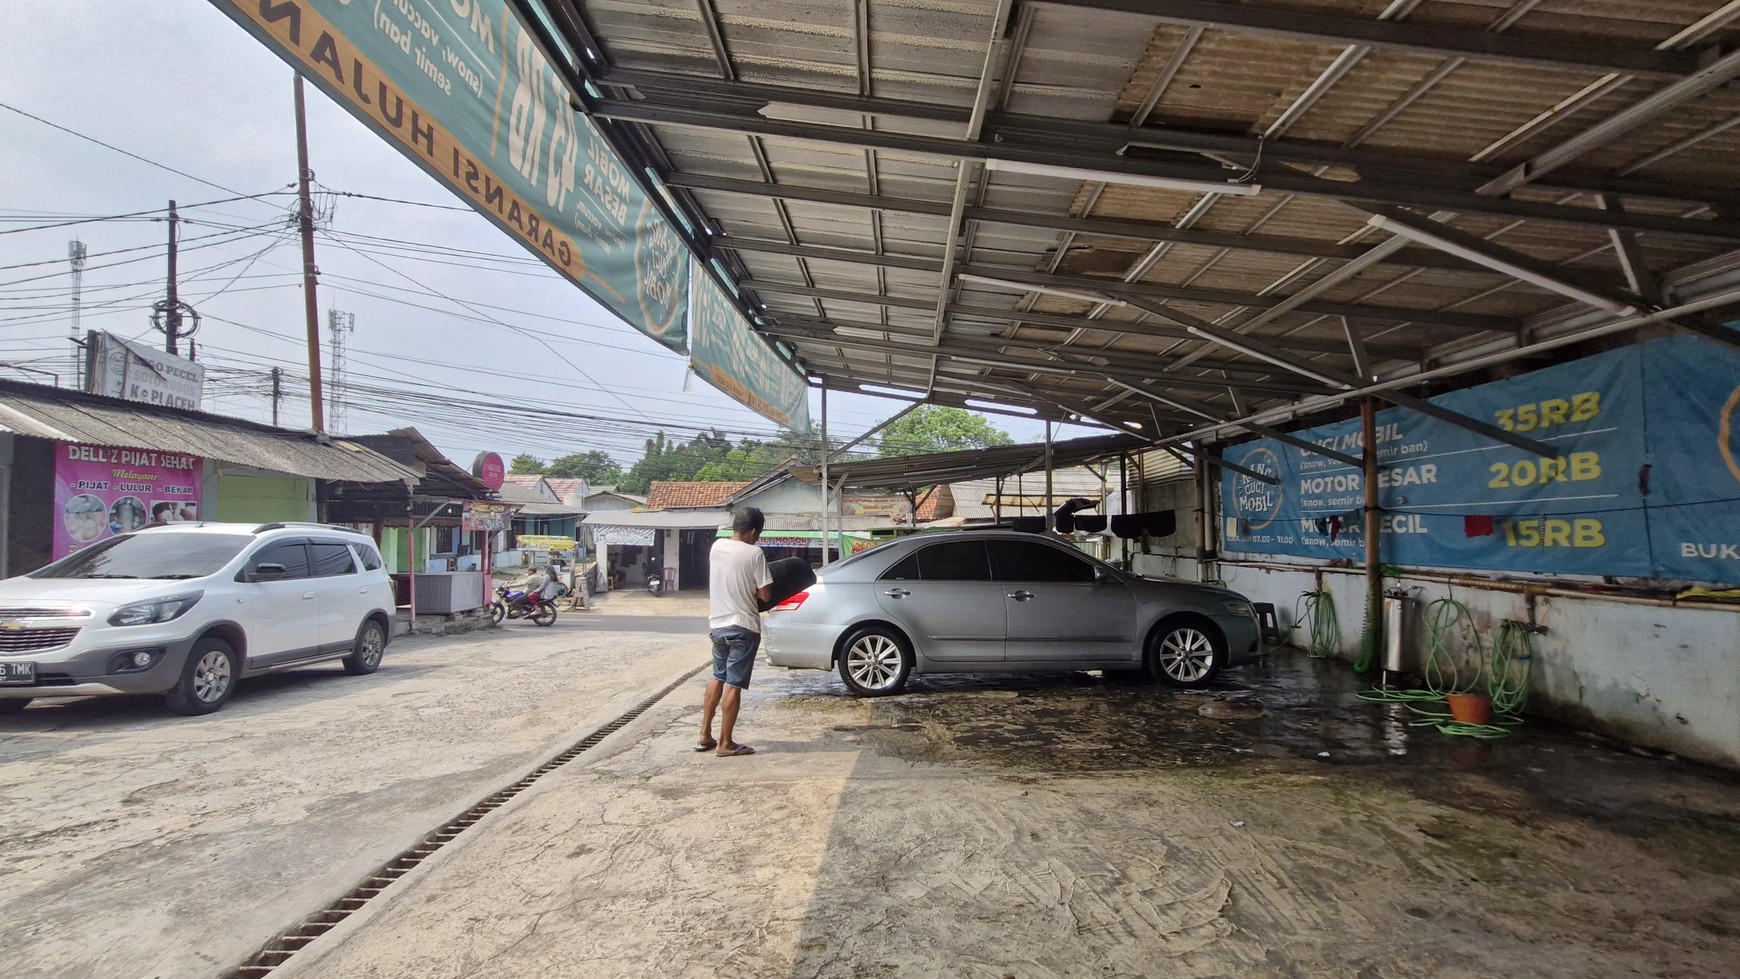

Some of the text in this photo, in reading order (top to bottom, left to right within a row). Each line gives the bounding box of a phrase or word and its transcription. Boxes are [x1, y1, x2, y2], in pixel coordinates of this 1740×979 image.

[165, 364, 199, 383] PECEL
[1494, 391, 1600, 432] 35RB
[1401, 440, 1428, 454] ban)
[121, 450, 158, 467] PIJAT
[1300, 464, 1437, 494] MOTOR ESAR
[1488, 451, 1602, 489] 20RB
[77, 480, 110, 490] PIJAT
[119, 483, 152, 493] LULUR
[163, 485, 194, 495] BEKAM
[1239, 490, 1273, 512] MOBIL
[1328, 496, 1354, 506] semir
[1379, 514, 1428, 534] ECIL
[1504, 518, 1606, 548] 15RB
[1301, 536, 1328, 547] (snow,
[11, 663, 31, 675] TMK
